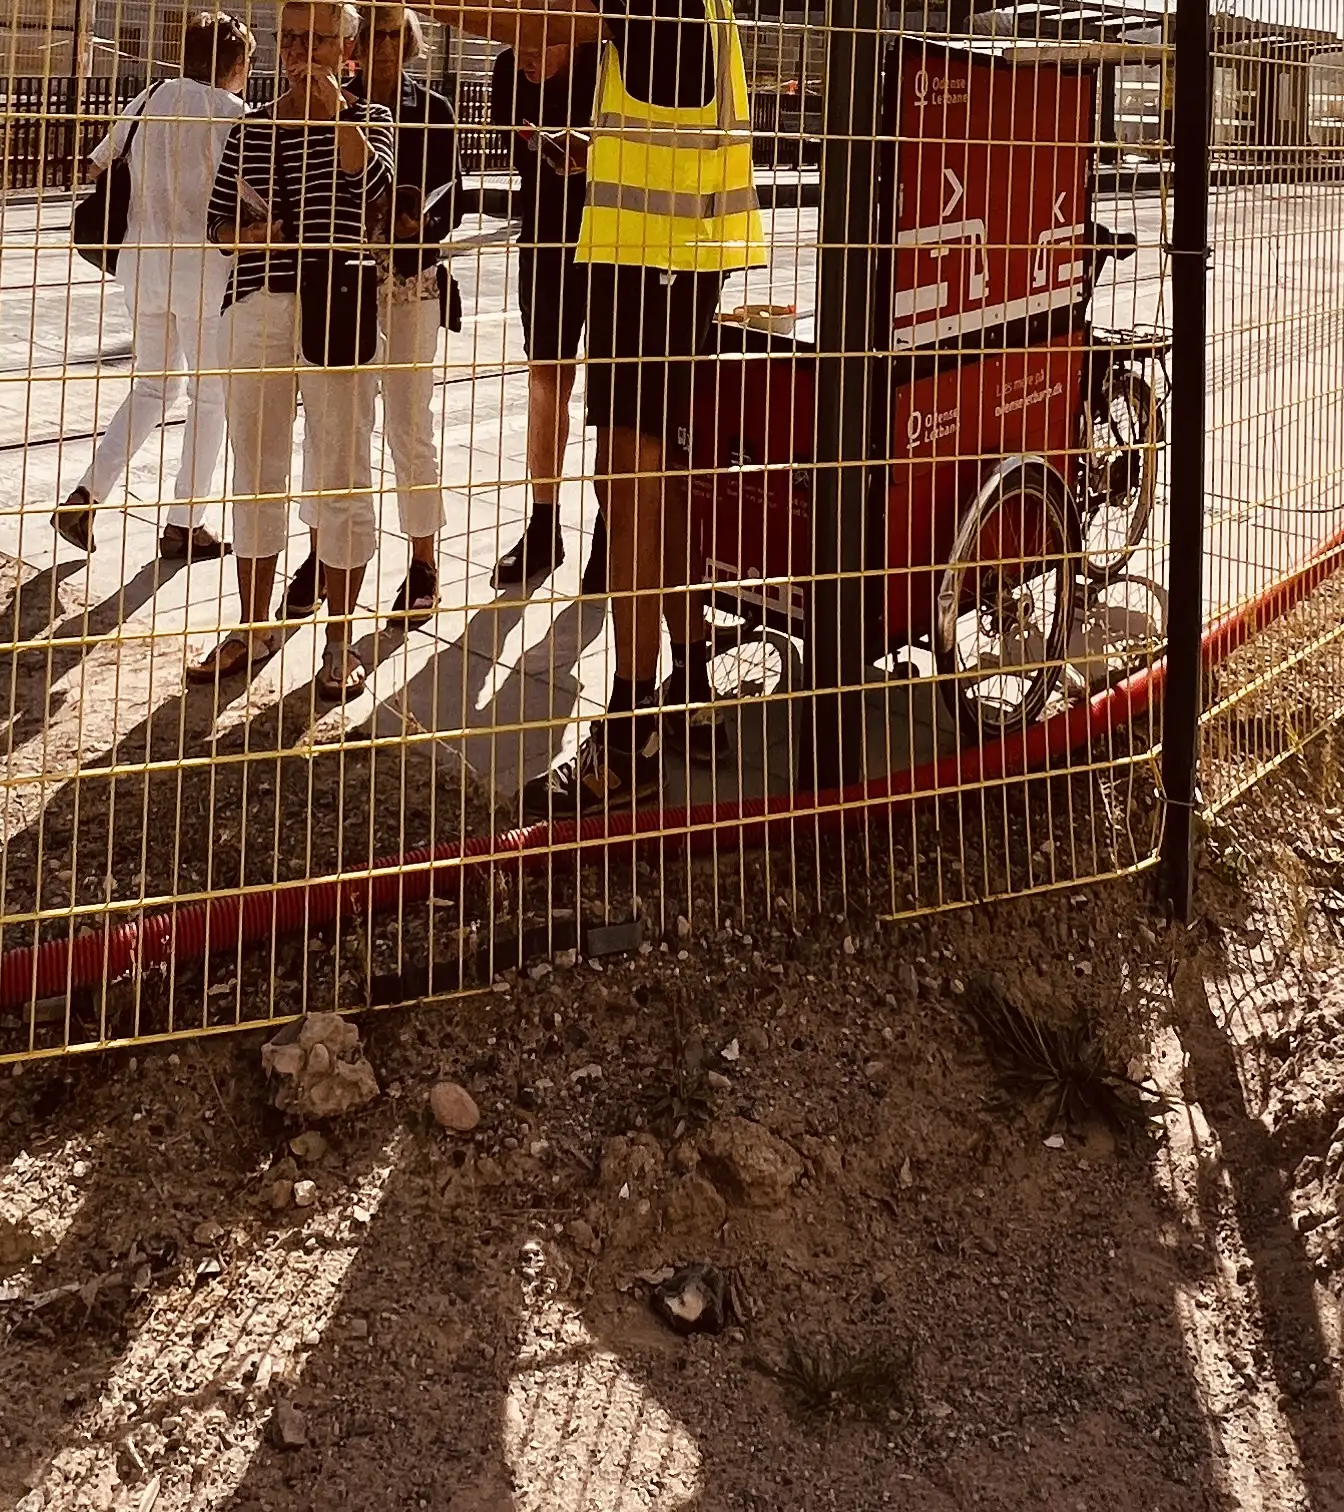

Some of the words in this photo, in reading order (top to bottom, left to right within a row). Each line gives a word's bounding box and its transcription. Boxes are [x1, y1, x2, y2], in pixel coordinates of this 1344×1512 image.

[932, 92, 969, 105] Lebane
[925, 407, 960, 428] Oense
[924, 423, 960, 443] Letban
